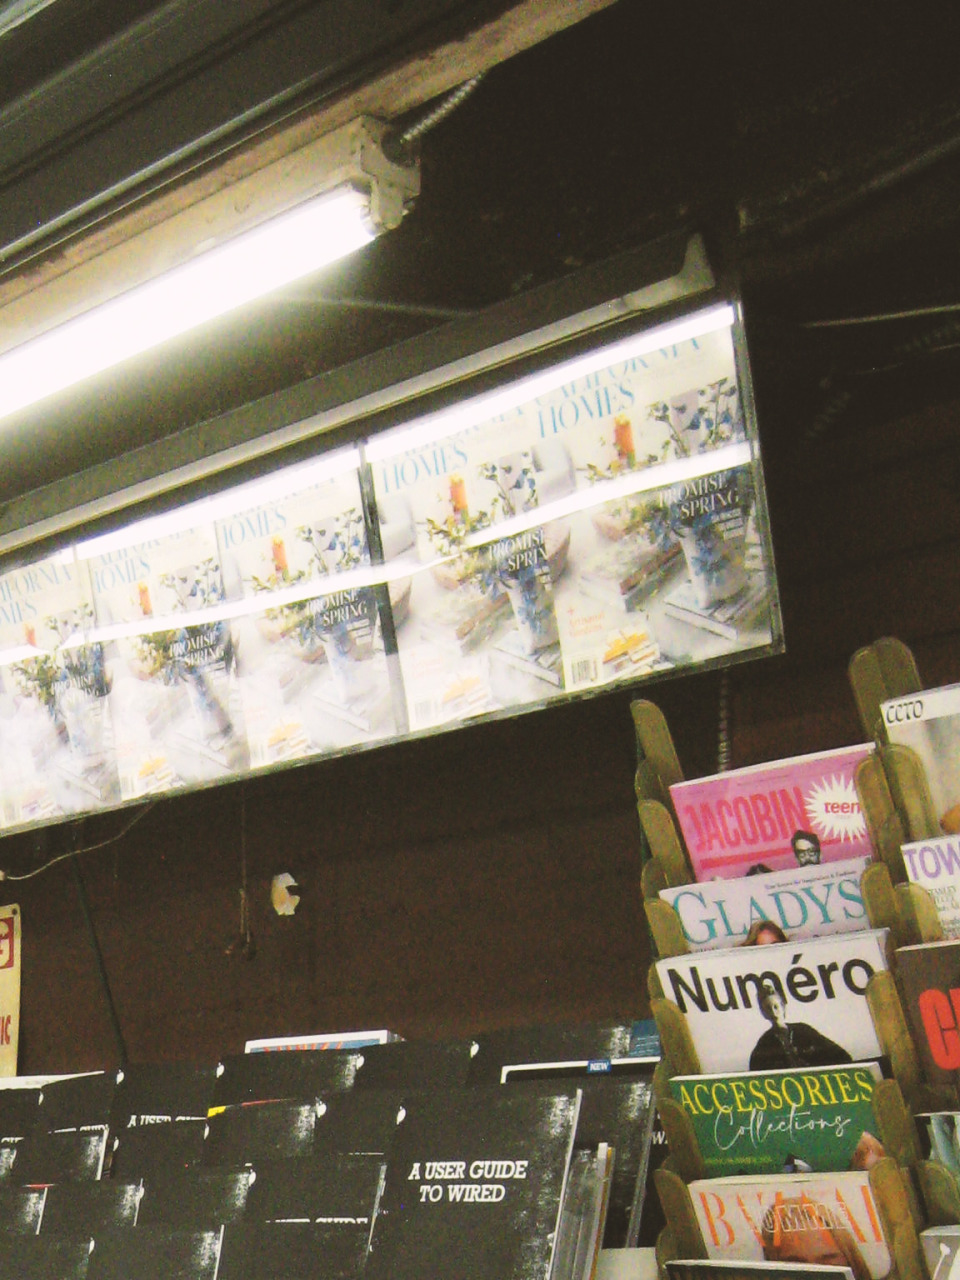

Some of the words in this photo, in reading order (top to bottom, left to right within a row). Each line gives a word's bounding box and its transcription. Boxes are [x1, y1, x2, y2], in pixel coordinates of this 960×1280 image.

[684, 786, 812, 851] JACOBIN
[673, 878, 867, 944] GLADYS
[667, 953, 874, 1014] Numéro
[680, 1069, 874, 1116] ACCESSORIES
[714, 1102, 851, 1150] Collections
[408, 1162, 421, 1180] A
[425, 1162, 466, 1179] USER
[469, 1161, 528, 1178] GUIDE
[420, 1186, 443, 1202] TO
[447, 1185, 505, 1202] WIRED
